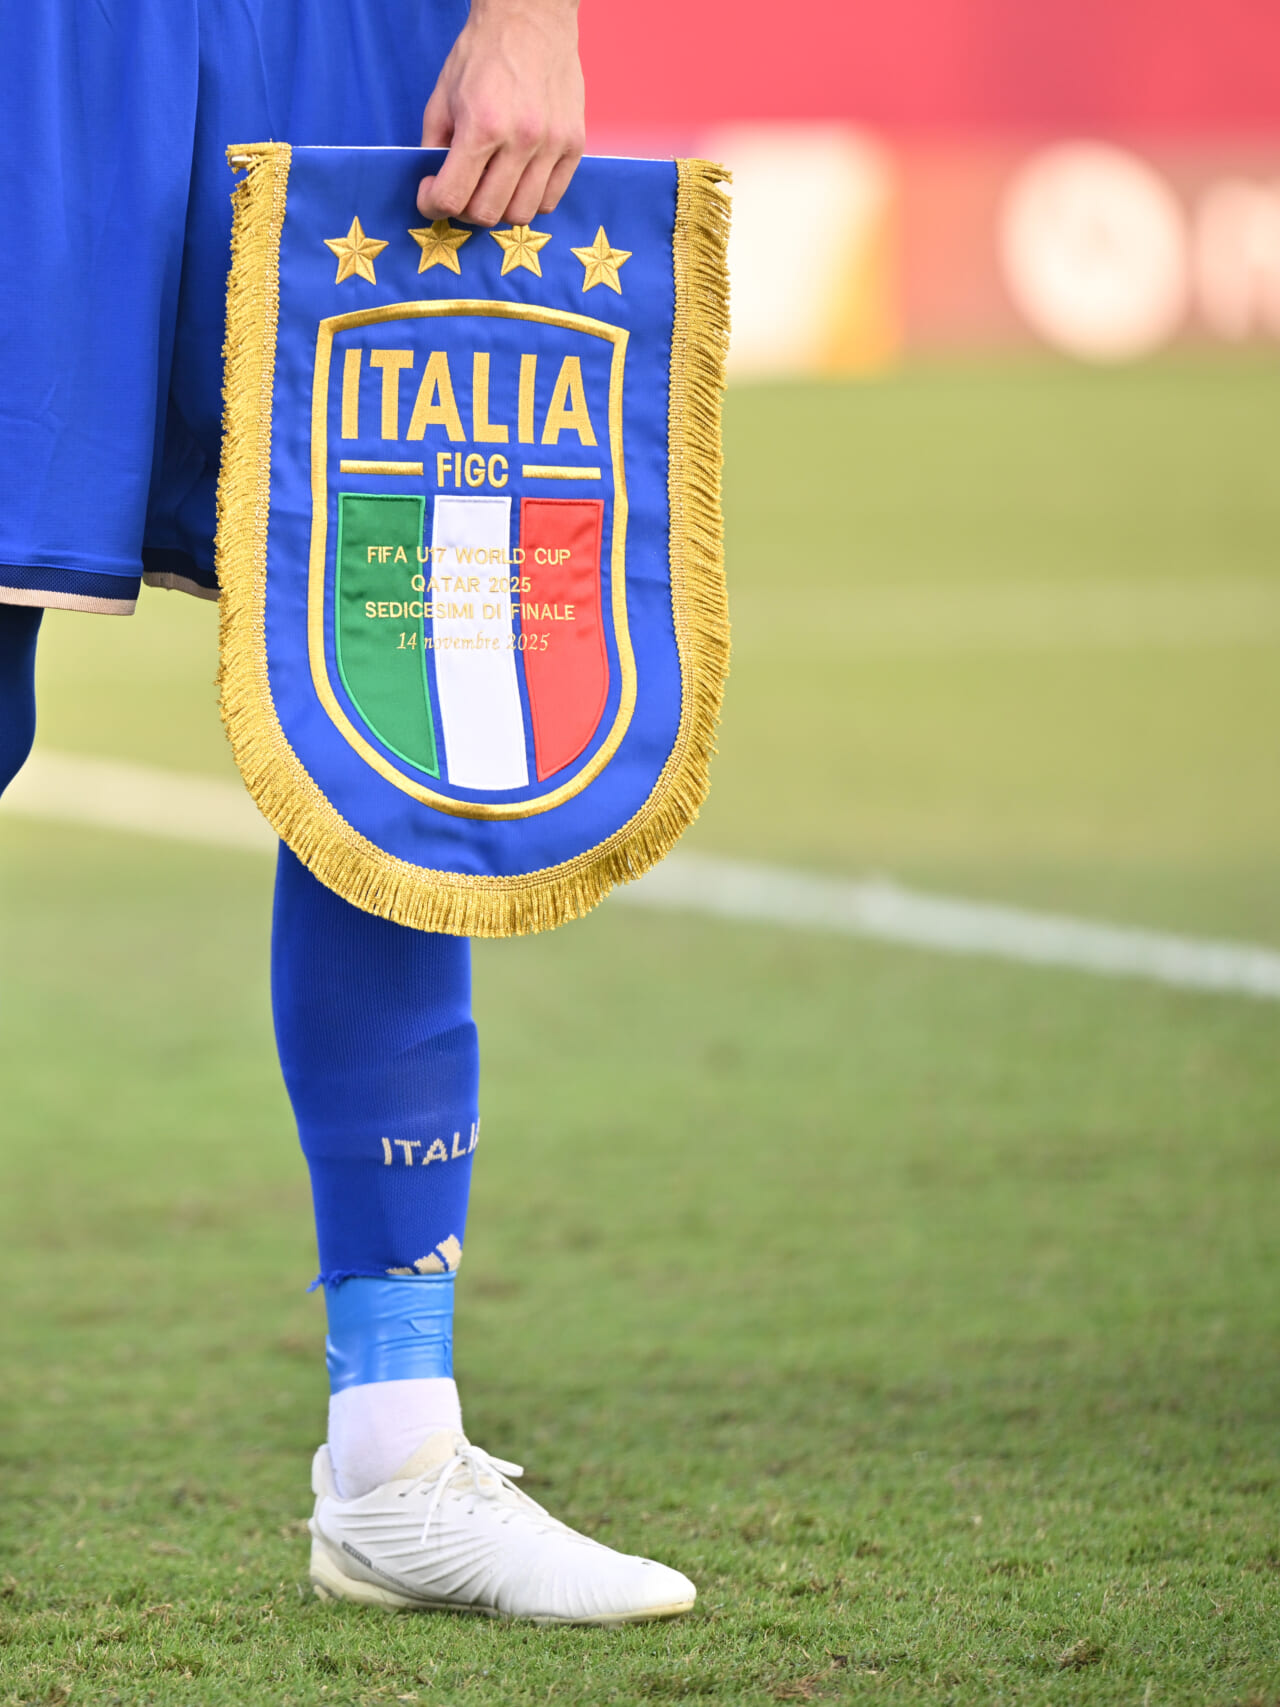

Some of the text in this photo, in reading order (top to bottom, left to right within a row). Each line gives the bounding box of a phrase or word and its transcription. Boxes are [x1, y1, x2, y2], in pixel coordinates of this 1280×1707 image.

[341, 348, 599, 446] ITALIA
[436, 452, 508, 488] FIGC
[367, 546, 571, 566] FIFA U17 WORLD CUP
[411, 574, 531, 593] QATAR 2025
[365, 601, 575, 621] SEDICESIMI DI FINALE
[396, 630, 551, 651] 14 novembre 2025
